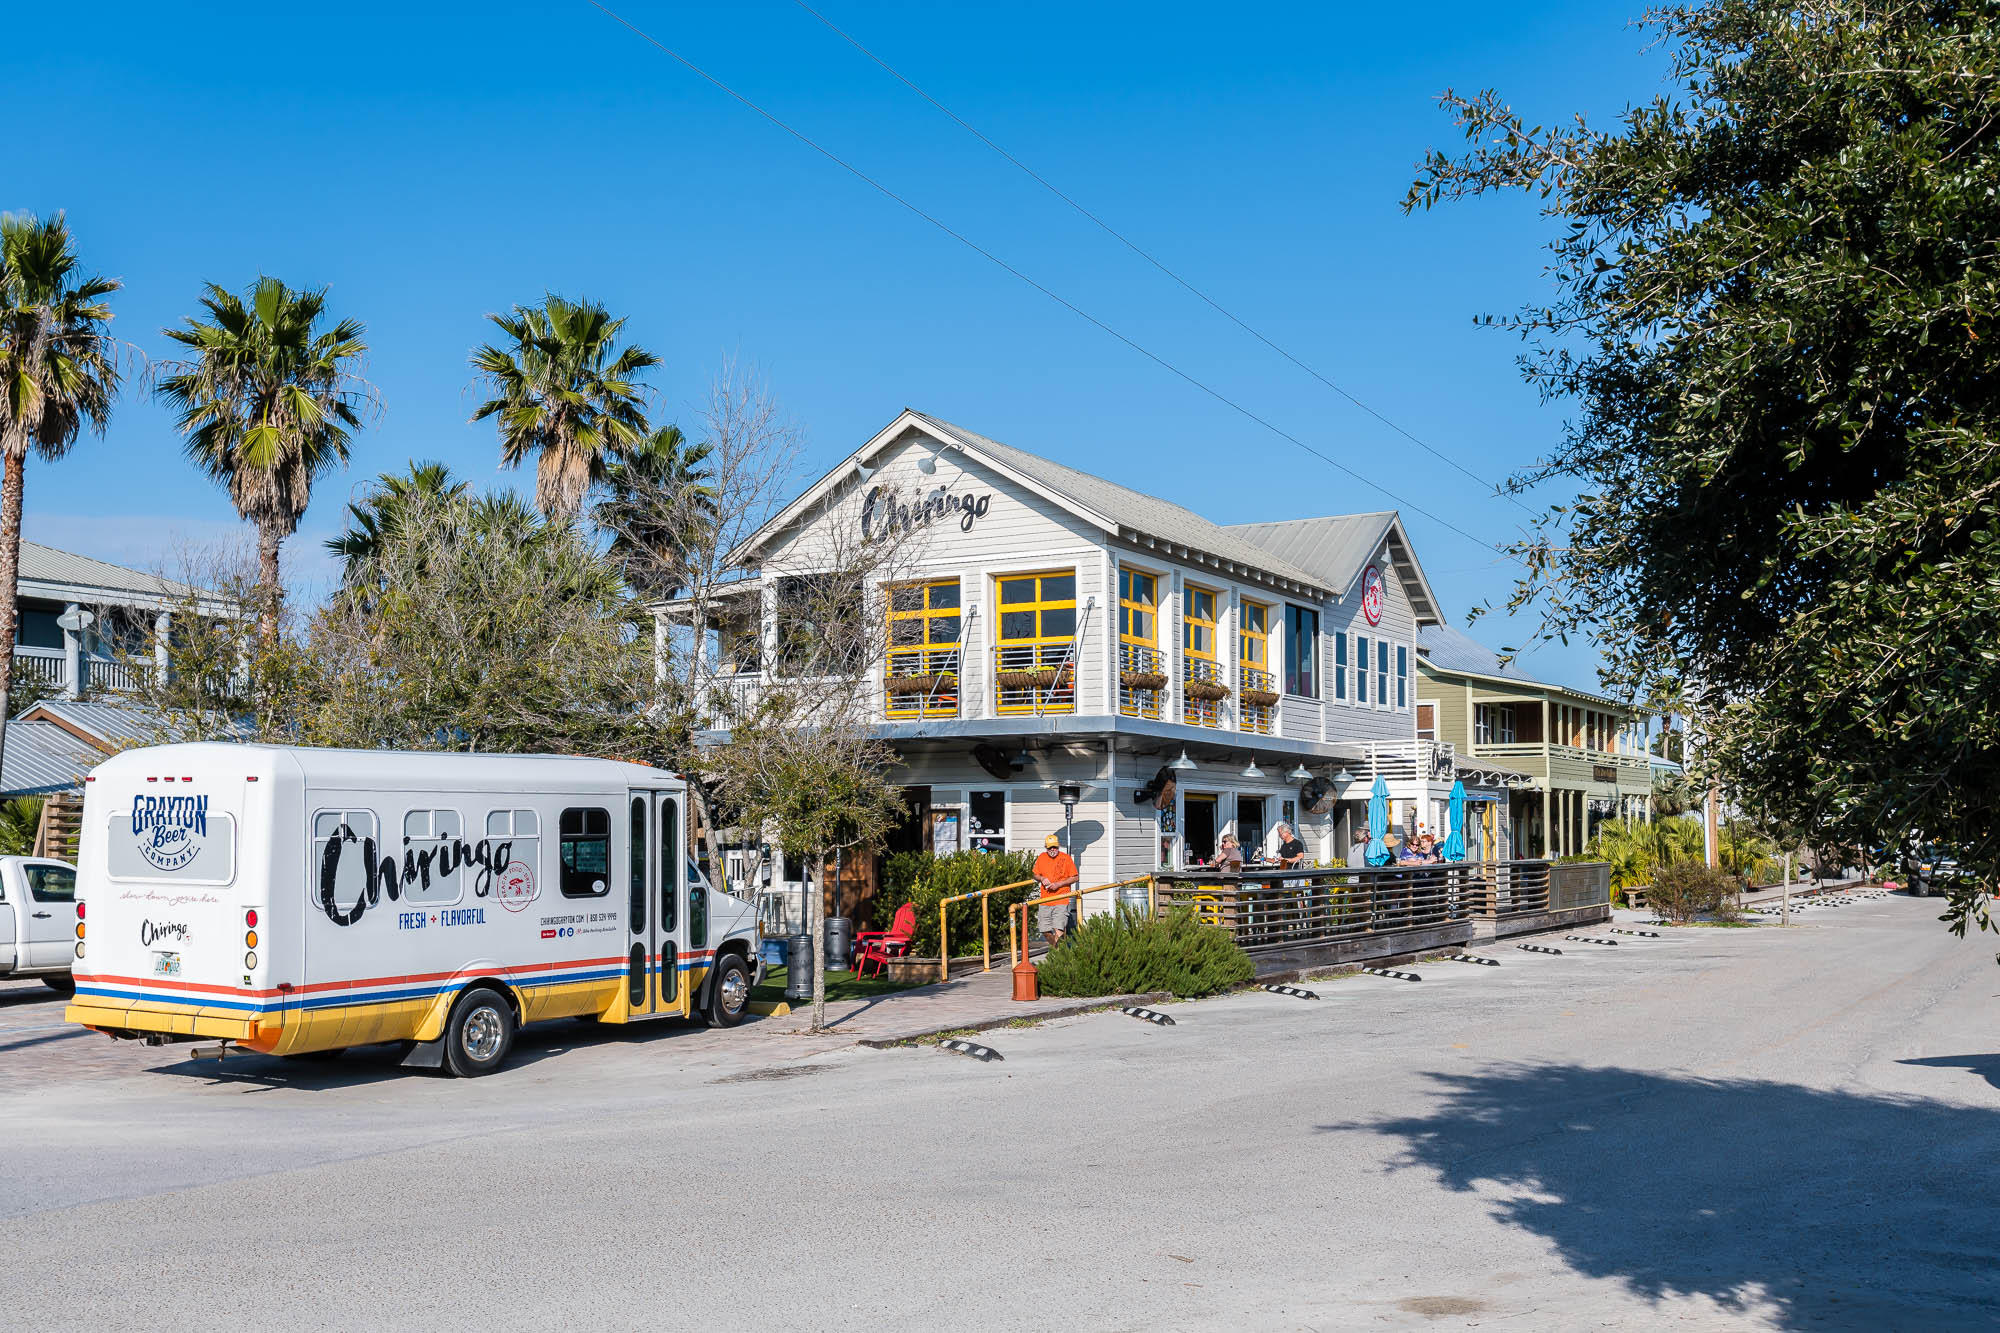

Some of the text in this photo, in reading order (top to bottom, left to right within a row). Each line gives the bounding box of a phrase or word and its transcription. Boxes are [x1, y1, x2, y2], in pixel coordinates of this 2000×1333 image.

[861, 485, 993, 545] Chiringo
[132, 794, 208, 838] GRAYTON
[152, 825, 188, 848] Beer
[145, 846, 192, 866] COMPANY
[320, 823, 513, 926] Chiringo
[141, 918, 187, 947] Chiringo
[399, 912, 427, 930] FRESH
[441, 907, 486, 927] FLAVORFUL
